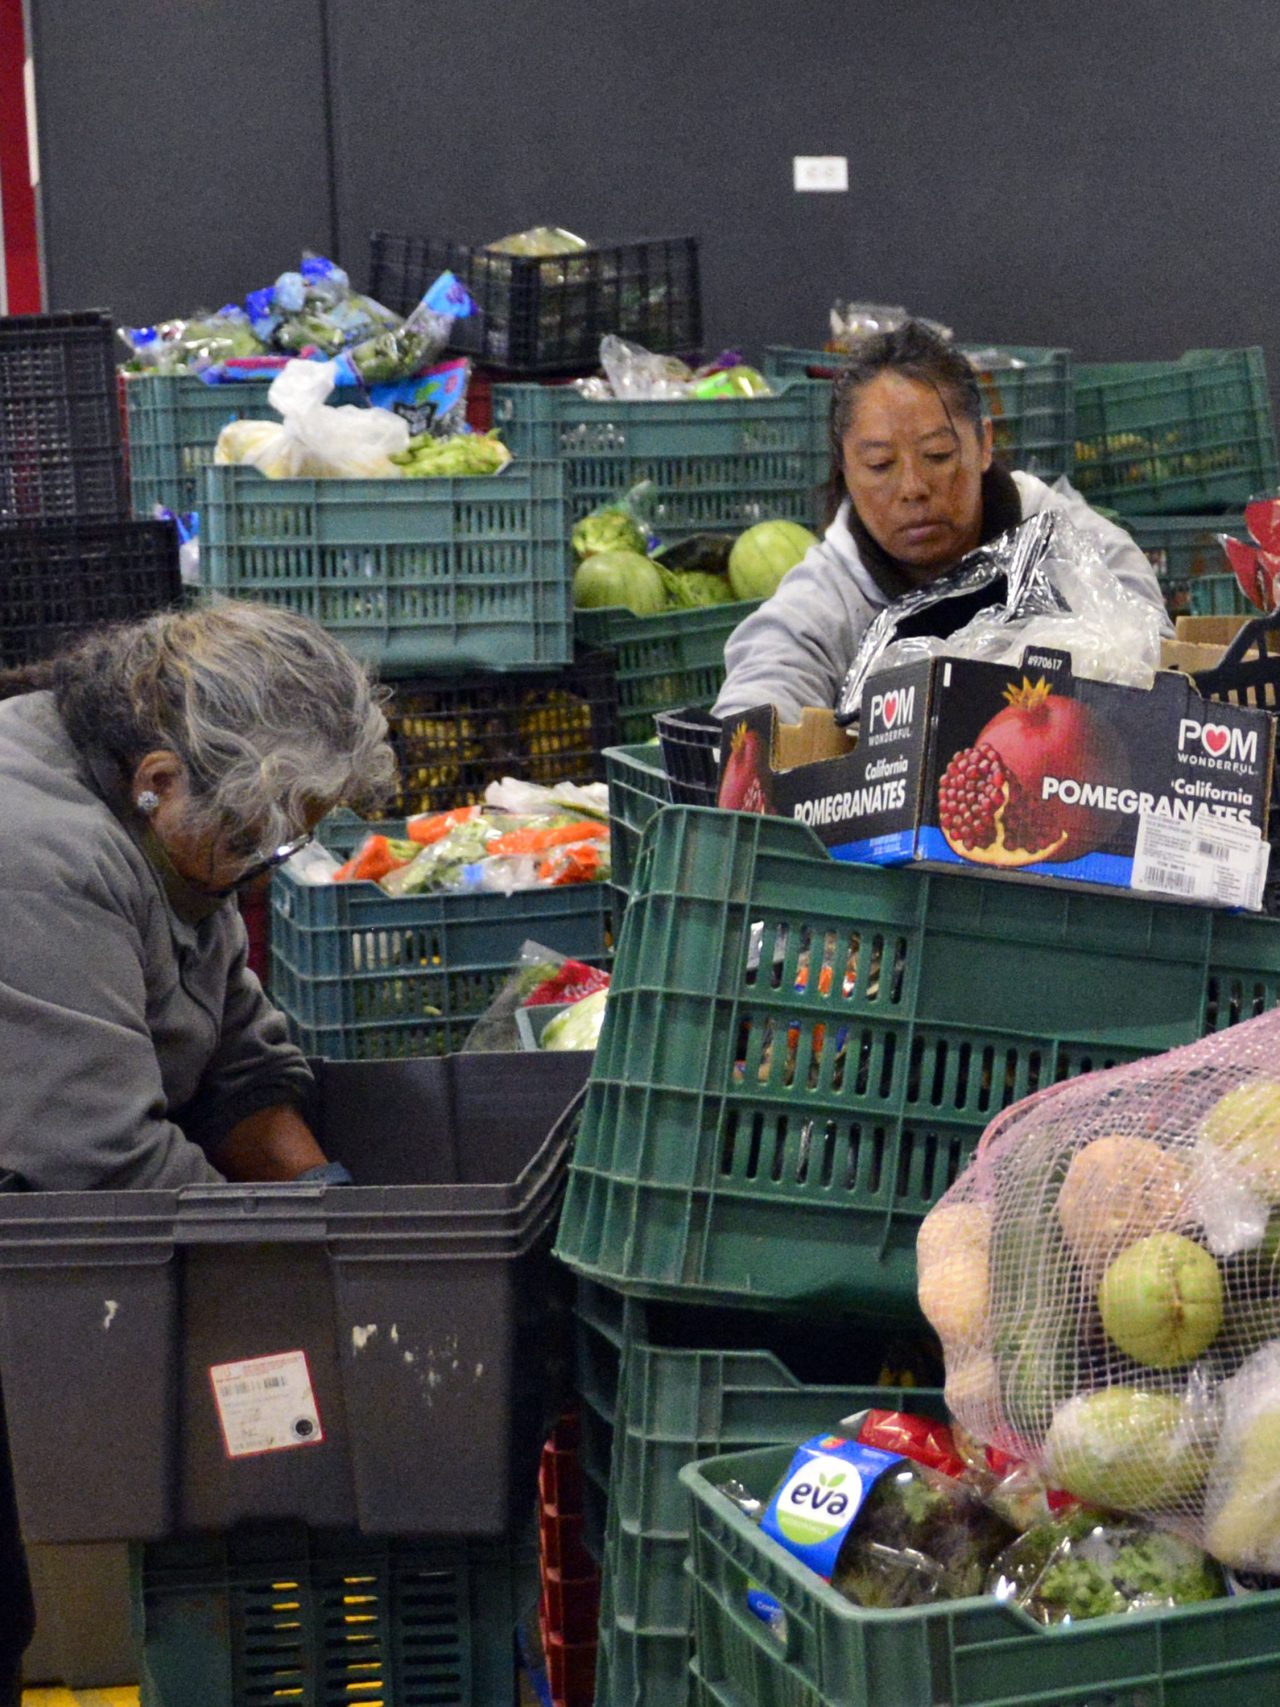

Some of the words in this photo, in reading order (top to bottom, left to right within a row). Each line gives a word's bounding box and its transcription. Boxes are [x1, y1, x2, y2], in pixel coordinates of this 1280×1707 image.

[1027, 655, 1063, 670] #970617
[869, 686, 915, 733] POM
[868, 728, 912, 747] WONDERFUL
[1177, 718, 1258, 764] POM
[864, 754, 909, 781] California
[1177, 752, 1256, 776] WONDERFUL
[794, 778, 907, 827] POMEGRANATES
[1174, 778, 1253, 805] California
[790, 1482, 849, 1516] eva
